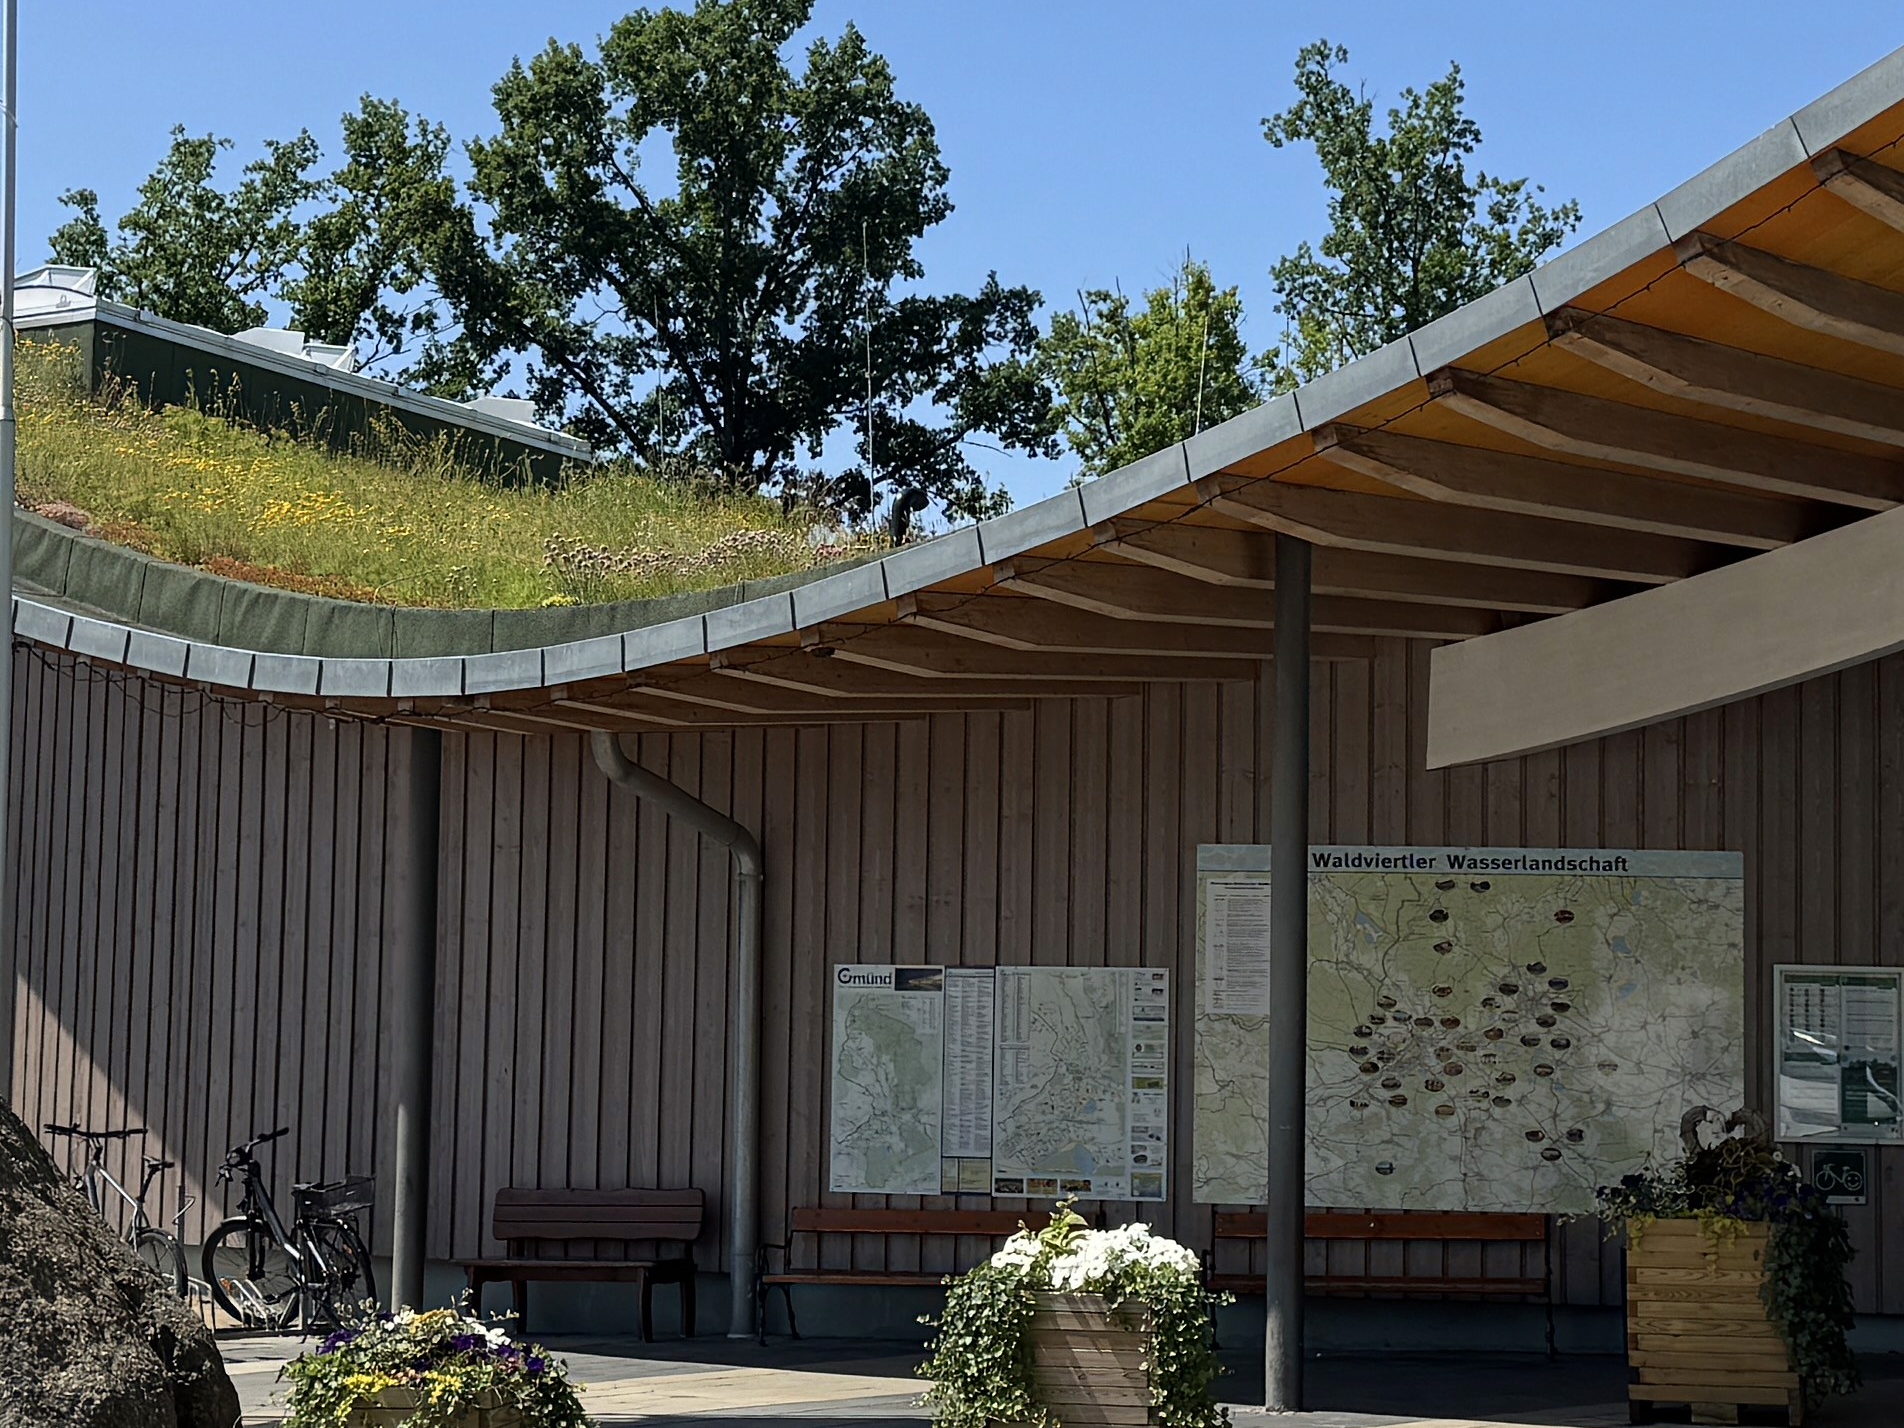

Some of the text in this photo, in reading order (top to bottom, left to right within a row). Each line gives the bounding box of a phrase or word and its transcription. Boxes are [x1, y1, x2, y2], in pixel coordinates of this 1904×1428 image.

[1311, 853, 1629, 872] Waldviertler Wasserlandschaft
[838, 967, 892, 985] Gmünd
